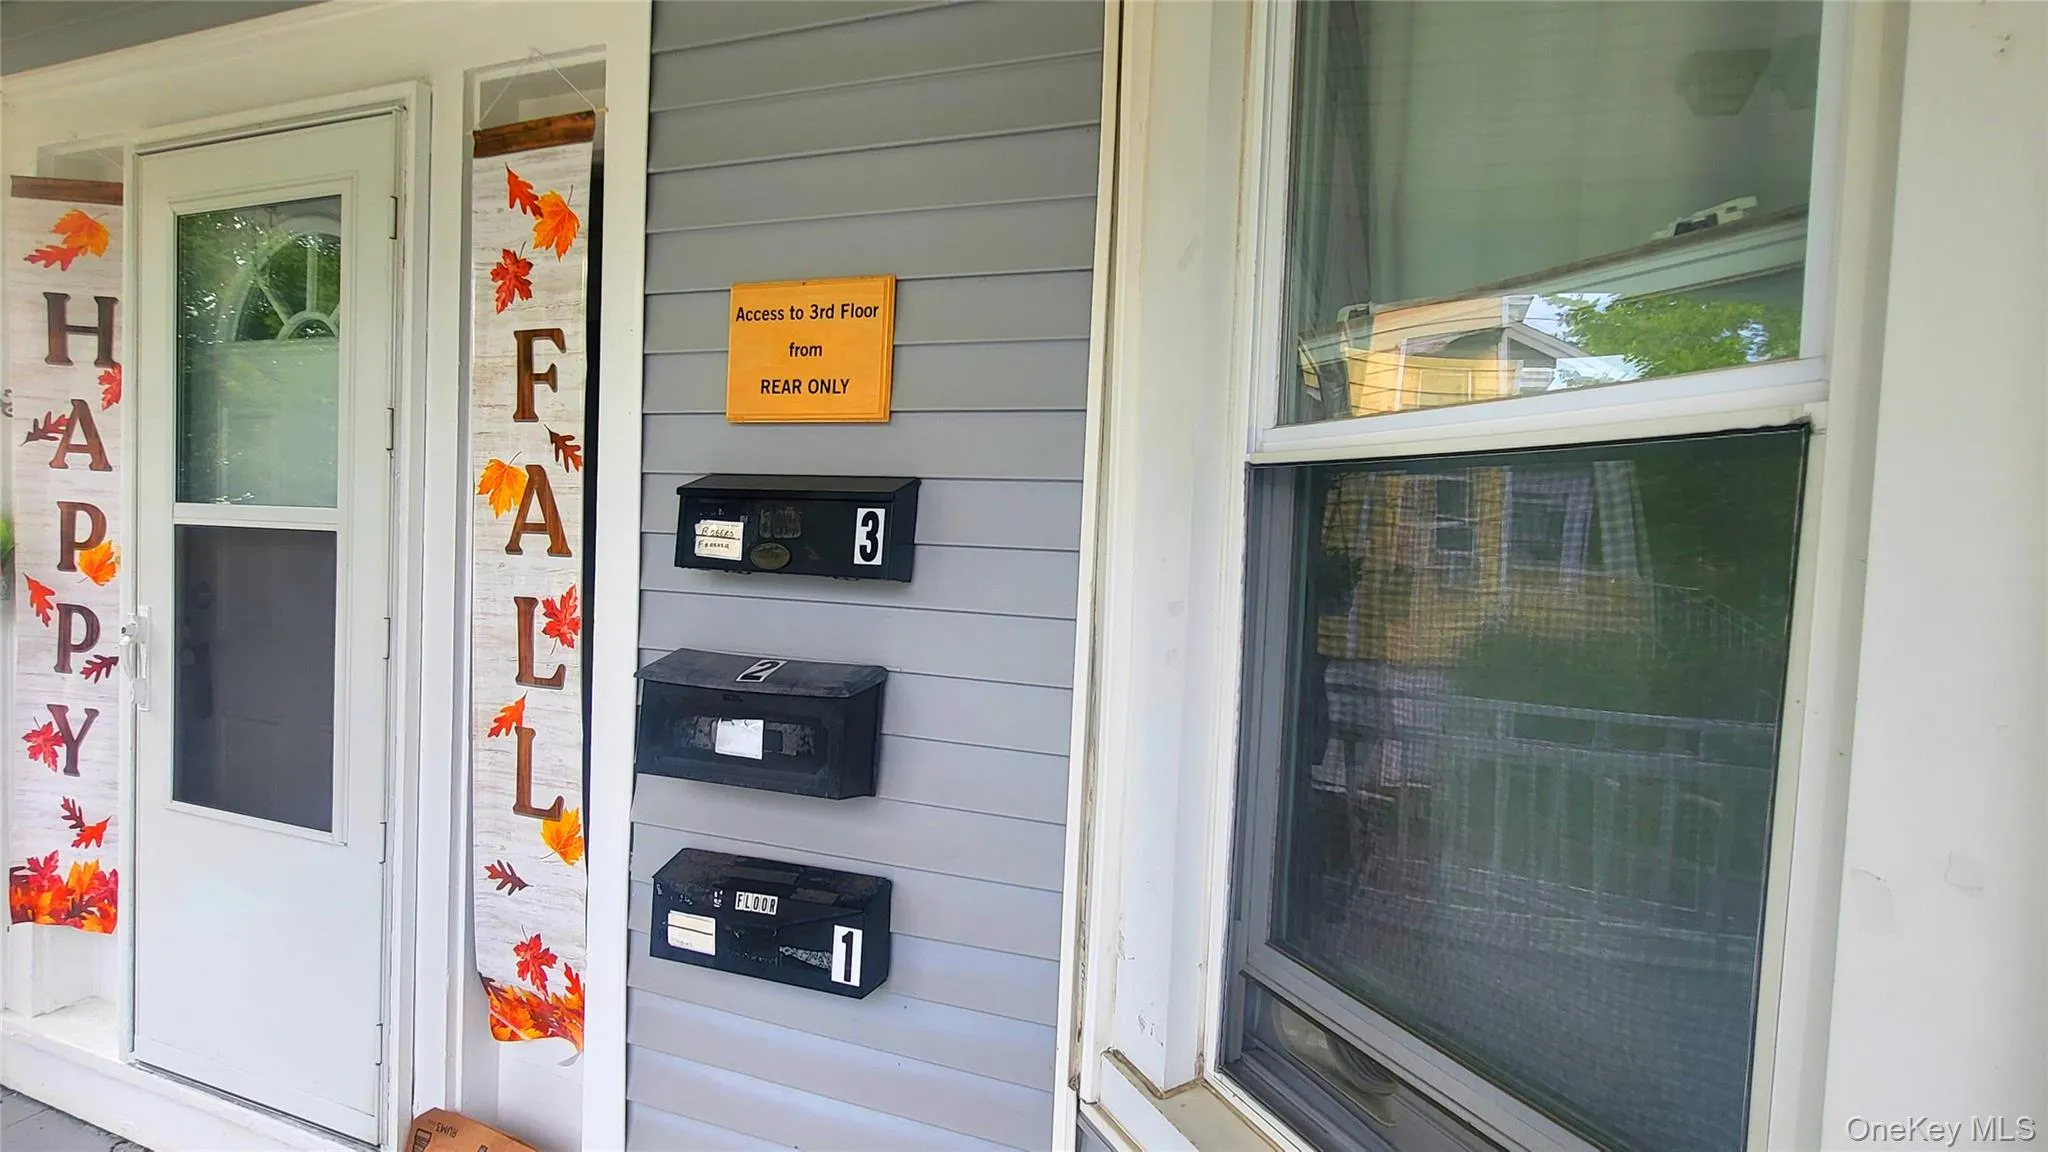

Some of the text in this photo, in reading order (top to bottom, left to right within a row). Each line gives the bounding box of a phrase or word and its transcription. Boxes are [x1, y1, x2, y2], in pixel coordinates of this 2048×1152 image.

[736, 303, 879, 322] Access to 3rd Floor
[789, 342, 823, 357] from
[760, 379, 850, 394] REAR ONLY
[43, 291, 119, 778] HAPPY
[859, 510, 880, 562] 3
[505, 328, 572, 821] FALL
[741, 661, 778, 681] 2
[736, 893, 777, 914] FLOOR
[841, 931, 854, 983] 1
